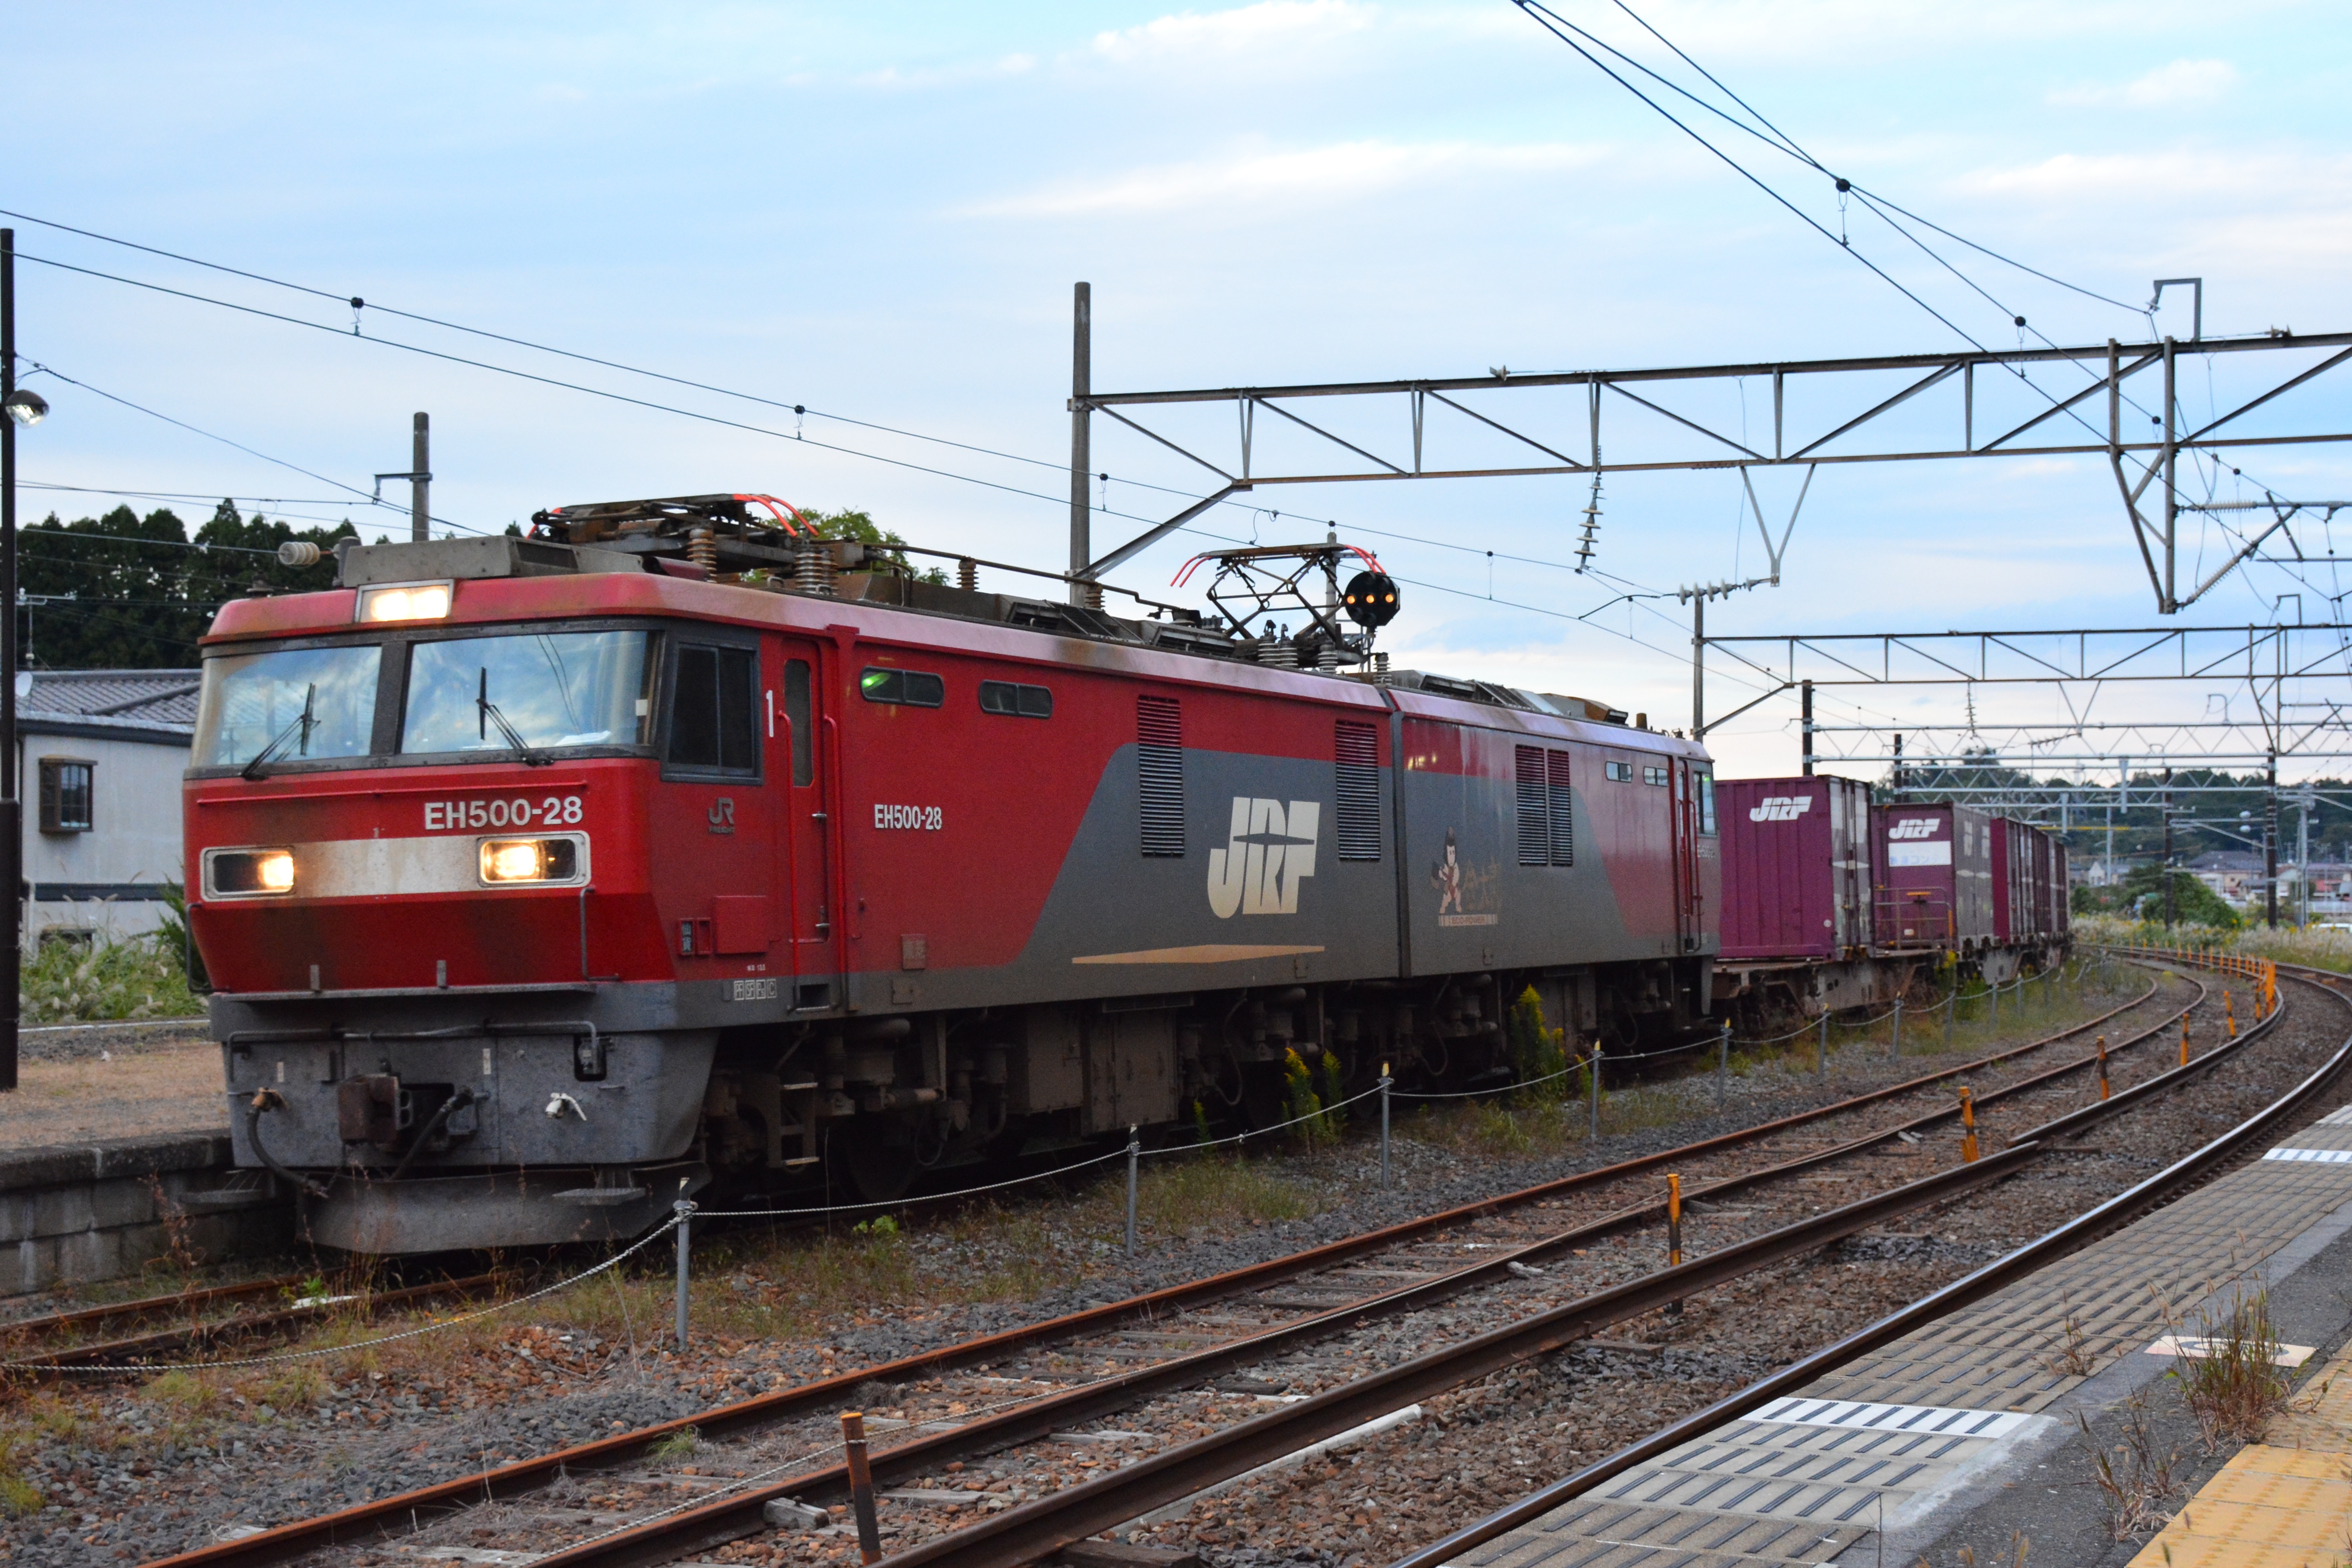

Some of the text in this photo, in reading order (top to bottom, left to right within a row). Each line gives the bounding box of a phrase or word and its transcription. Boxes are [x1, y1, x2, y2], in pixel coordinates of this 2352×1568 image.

[766, 690, 774, 737] 1
[424, 796, 583, 830] EH500-28
[708, 797, 735, 824] JR
[874, 804, 942, 830] EH500-28
[1749, 796, 1812, 822] JRF
[1888, 818, 1940, 839] JRF
[1207, 797, 1320, 919] JRF
